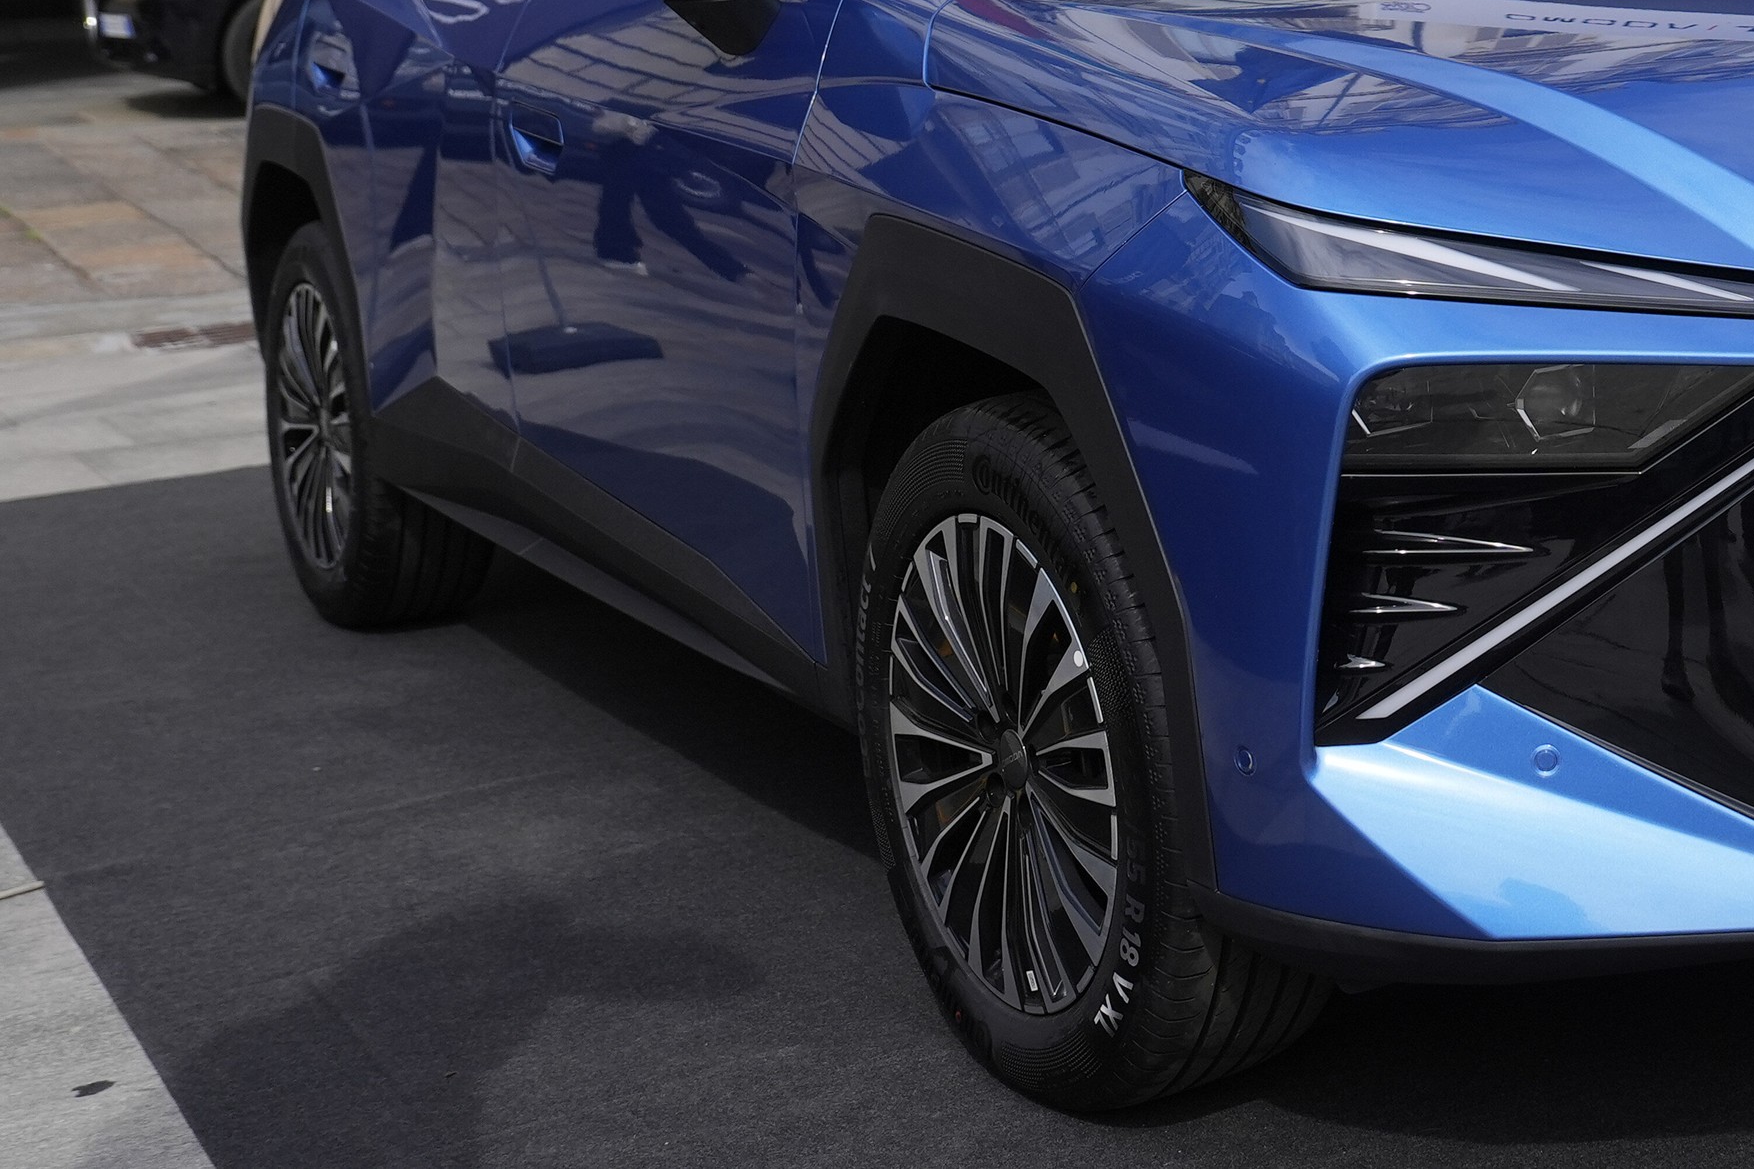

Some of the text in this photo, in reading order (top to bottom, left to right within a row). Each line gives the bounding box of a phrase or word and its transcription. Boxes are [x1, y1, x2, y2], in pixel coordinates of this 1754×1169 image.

[1119, 931, 1143, 968] 18
[1111, 971, 1135, 1005] V
[1093, 992, 1124, 1039] XL
